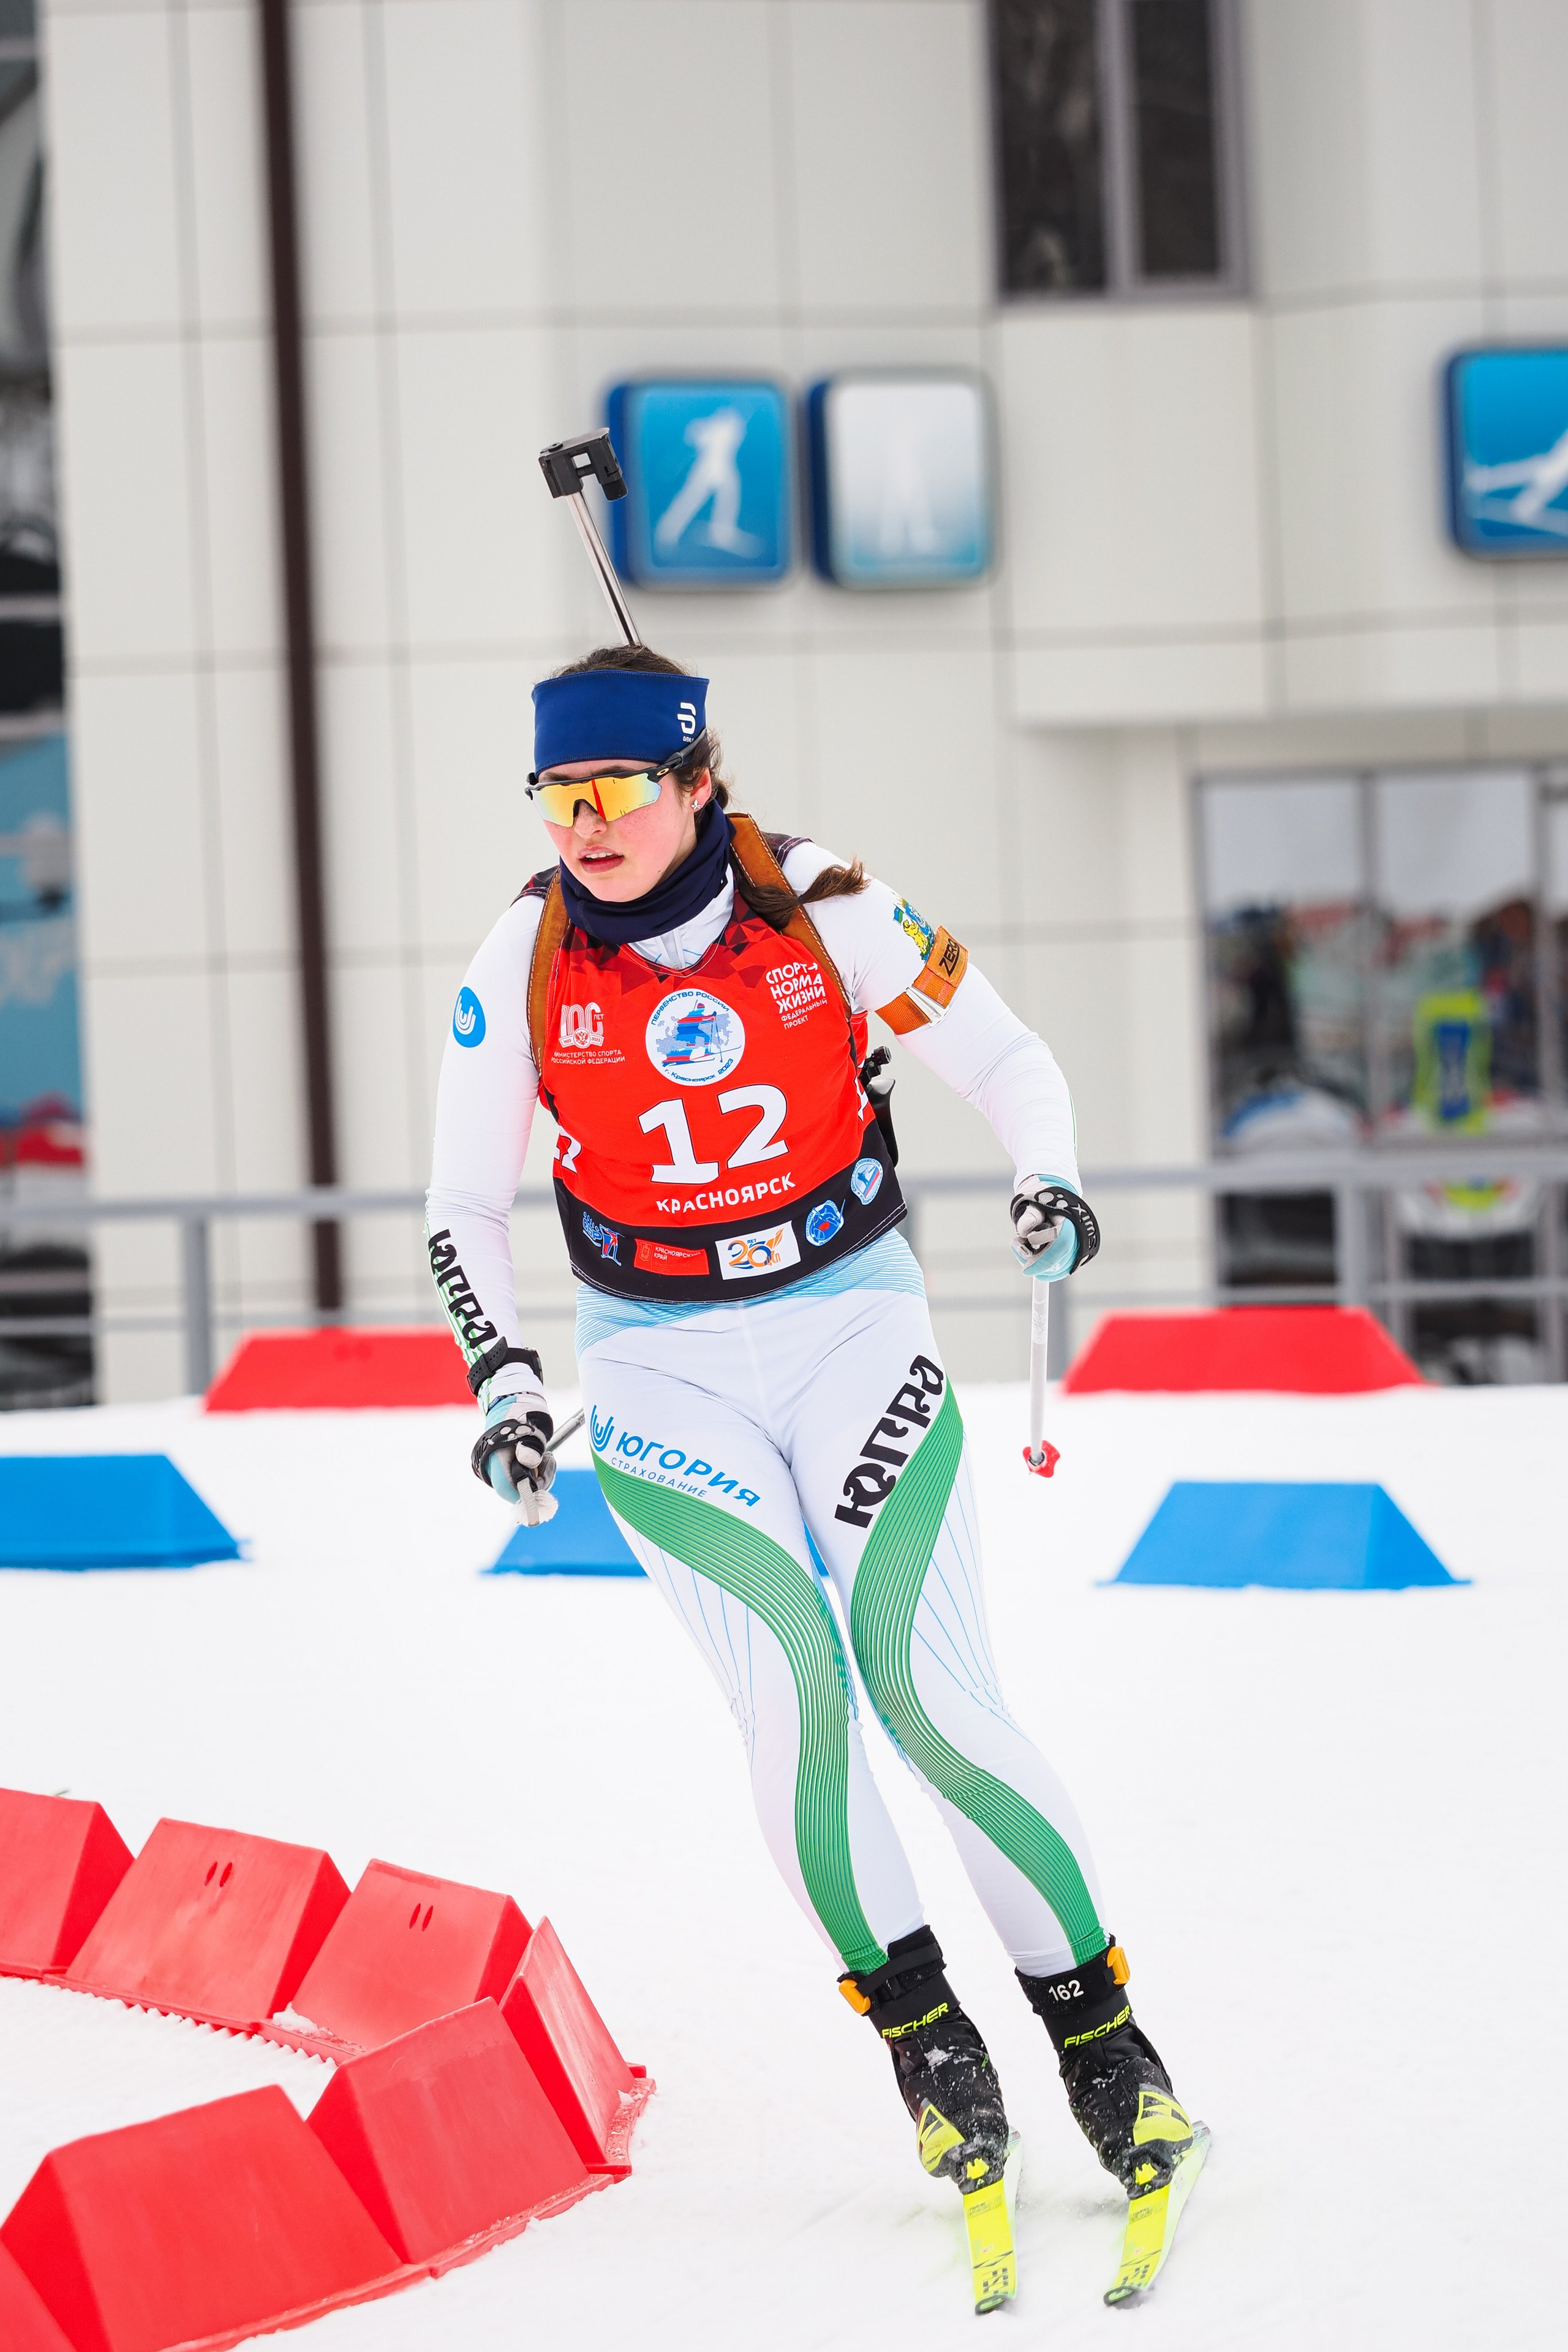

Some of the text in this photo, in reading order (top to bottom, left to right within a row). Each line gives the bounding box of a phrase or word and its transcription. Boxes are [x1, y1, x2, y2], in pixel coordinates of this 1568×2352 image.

[938, 938, 960, 978] ZERO
[766, 962, 808, 984] СПОРТ
[769, 973, 823, 1000] НОРМА
[650, 991, 729, 1025] ПЕРВЕНСТВО РОССИИ
[775, 986, 826, 1014] ЖИЗНИ
[780, 998, 827, 1022] ФЕДЕРАЛЬНЫЙ
[783, 1014, 809, 1030] ПРОЕКТ
[551, 1056, 625, 1065] РОССИЙСКОЙ ФЕДЕРАЦИИ
[671, 1071, 716, 1082] Красноярск
[717, 1058, 734, 1075] 2023
[637, 1084, 790, 1185] 12
[656, 1172, 796, 1214] КРАСНОЯРСК
[654, 1253, 668, 1261] КРАЙ
[611, 1457, 707, 1498] СТРАХОВАНИЕ
[615, 1431, 761, 1507] ЮГОРИЯ
[1048, 1980, 1084, 2001] 162
[881, 2002, 949, 2038] FISCHER
[1064, 2005, 1131, 2049] FISCHER
